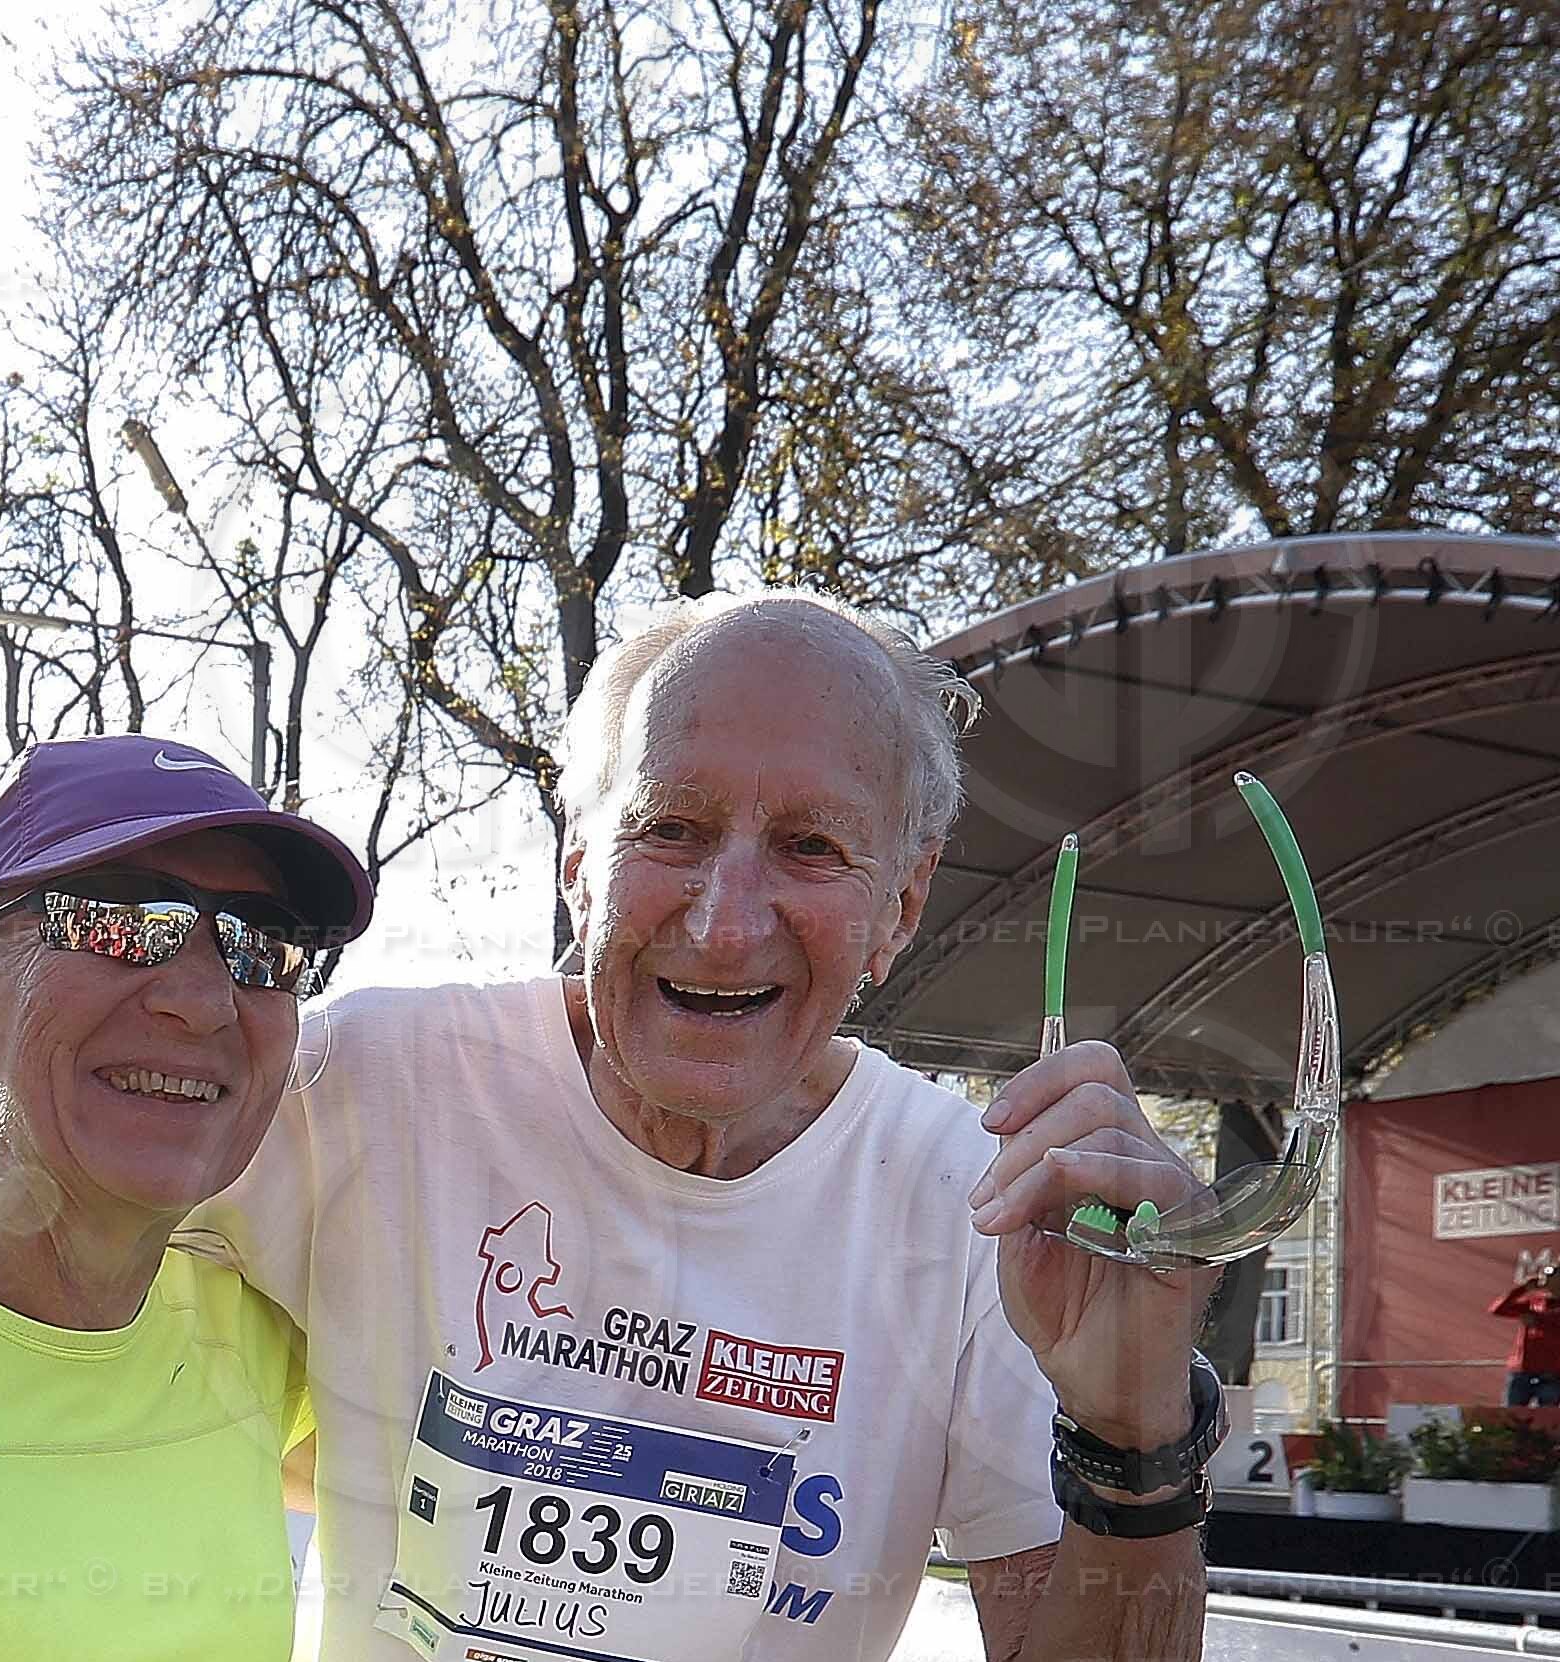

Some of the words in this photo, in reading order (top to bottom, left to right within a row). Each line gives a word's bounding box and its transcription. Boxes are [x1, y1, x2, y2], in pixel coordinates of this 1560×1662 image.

[1442, 1170, 1556, 1202] KLEINE
[603, 1307, 697, 1358] GRAZ
[500, 1321, 690, 1396] MARATHON
[709, 1339, 838, 1386] KLEINE
[447, 1402, 482, 1425] ZEITUNG
[449, 1393, 485, 1414] KLEINE
[702, 1370, 832, 1416] ZEITUNG
[462, 1430, 554, 1462] MARATHON
[490, 1407, 591, 1449] GRAZ
[523, 1462, 564, 1481] 2018
[613, 1443, 633, 1458] 25
[1247, 1440, 1274, 1483] 2
[664, 1482, 744, 1511] GRAZ
[777, 1474, 844, 1558] S
[474, 1486, 676, 1584] 1839
[478, 1561, 522, 1583] Kleine
[524, 1568, 576, 1595] Zeitung
[579, 1579, 644, 1604] Marathon
[458, 1579, 609, 1638] JULIUS
